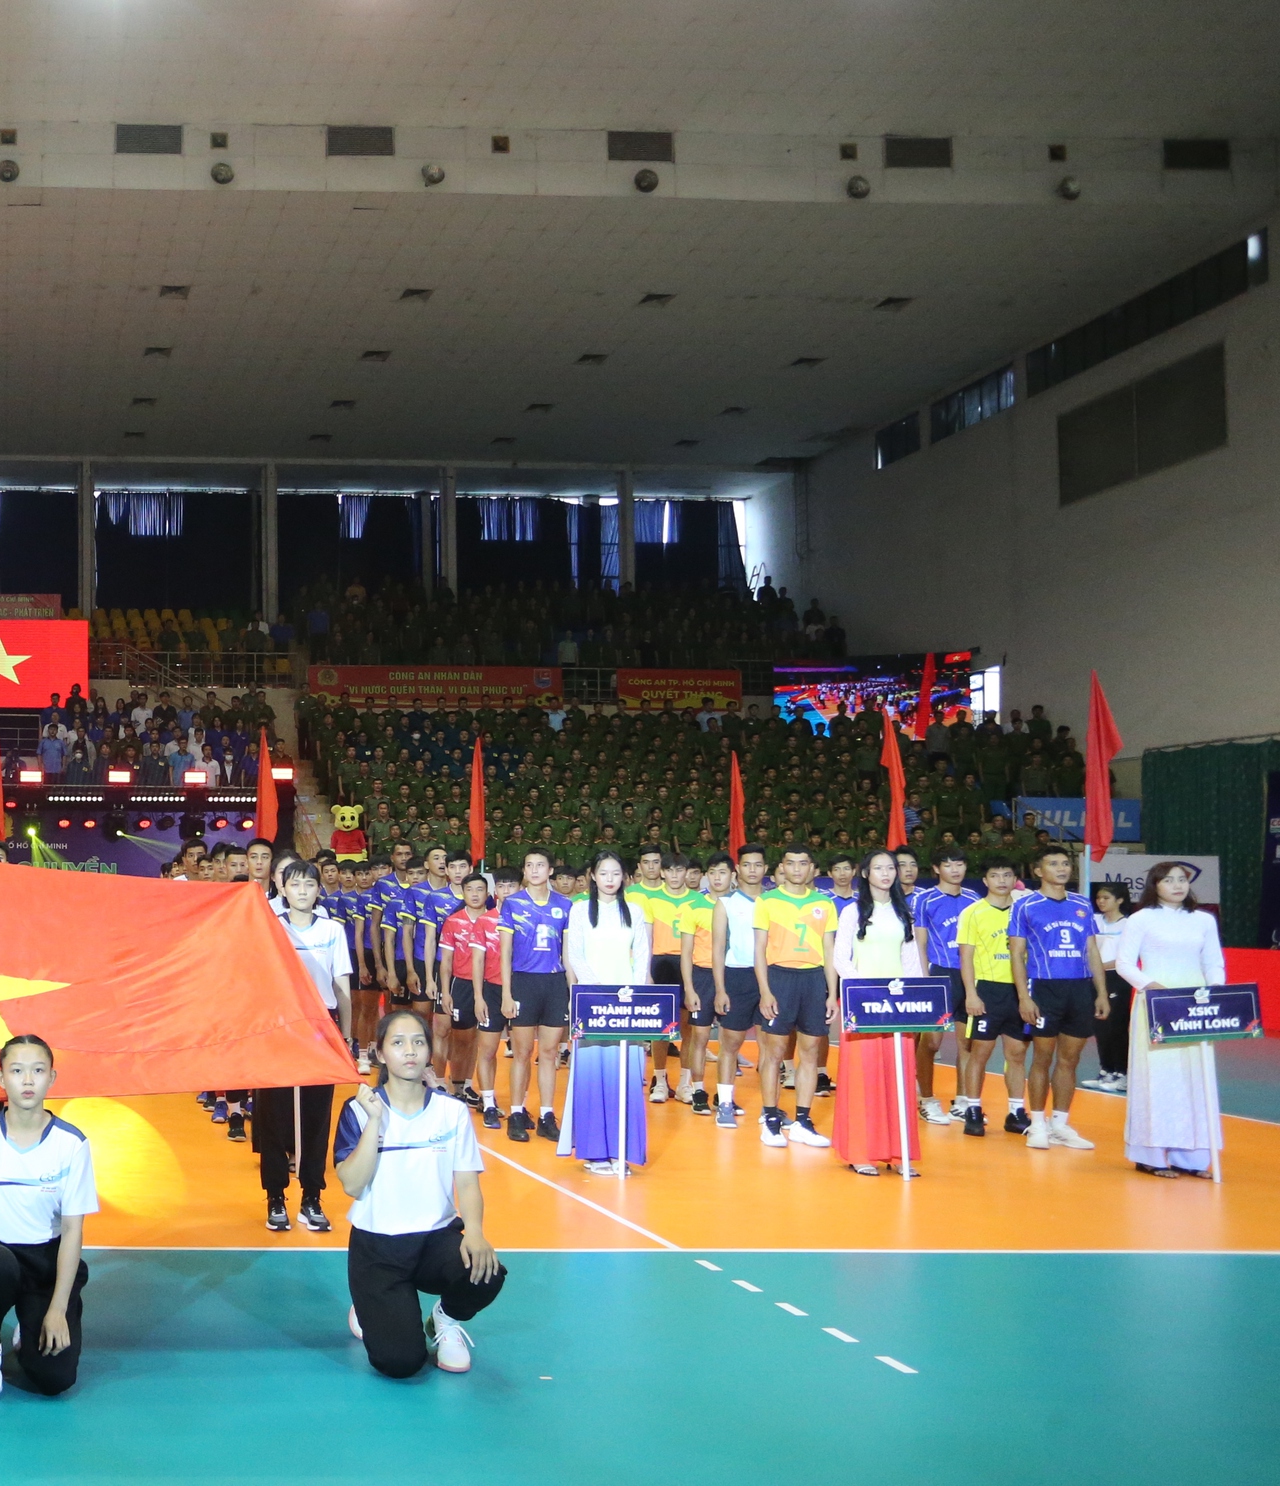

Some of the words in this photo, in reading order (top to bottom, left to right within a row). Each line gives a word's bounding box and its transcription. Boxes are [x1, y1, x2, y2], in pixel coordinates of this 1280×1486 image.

[388, 670, 414, 681] CÔNG
[417, 672, 431, 681] AN
[628, 678, 652, 686] CÔNG
[641, 687, 680, 699] QUYẾT
[535, 924, 548, 947] 2
[794, 923, 807, 946] 7
[1060, 929, 1071, 943] 9
[590, 1004, 632, 1015] THÀNH
[634, 1003, 660, 1015] PHỐ
[861, 999, 893, 1013] TRÀ
[894, 1001, 933, 1013] VINH
[1187, 1005, 1220, 1017] XSKT
[588, 1015, 606, 1027] HỒ
[608, 1016, 629, 1028] CHÍ
[631, 1018, 662, 1028] MINH
[978, 1020, 987, 1032] 2
[1170, 1018, 1202, 1031] VĨNH
[1204, 1017, 1240, 1029] LONG
